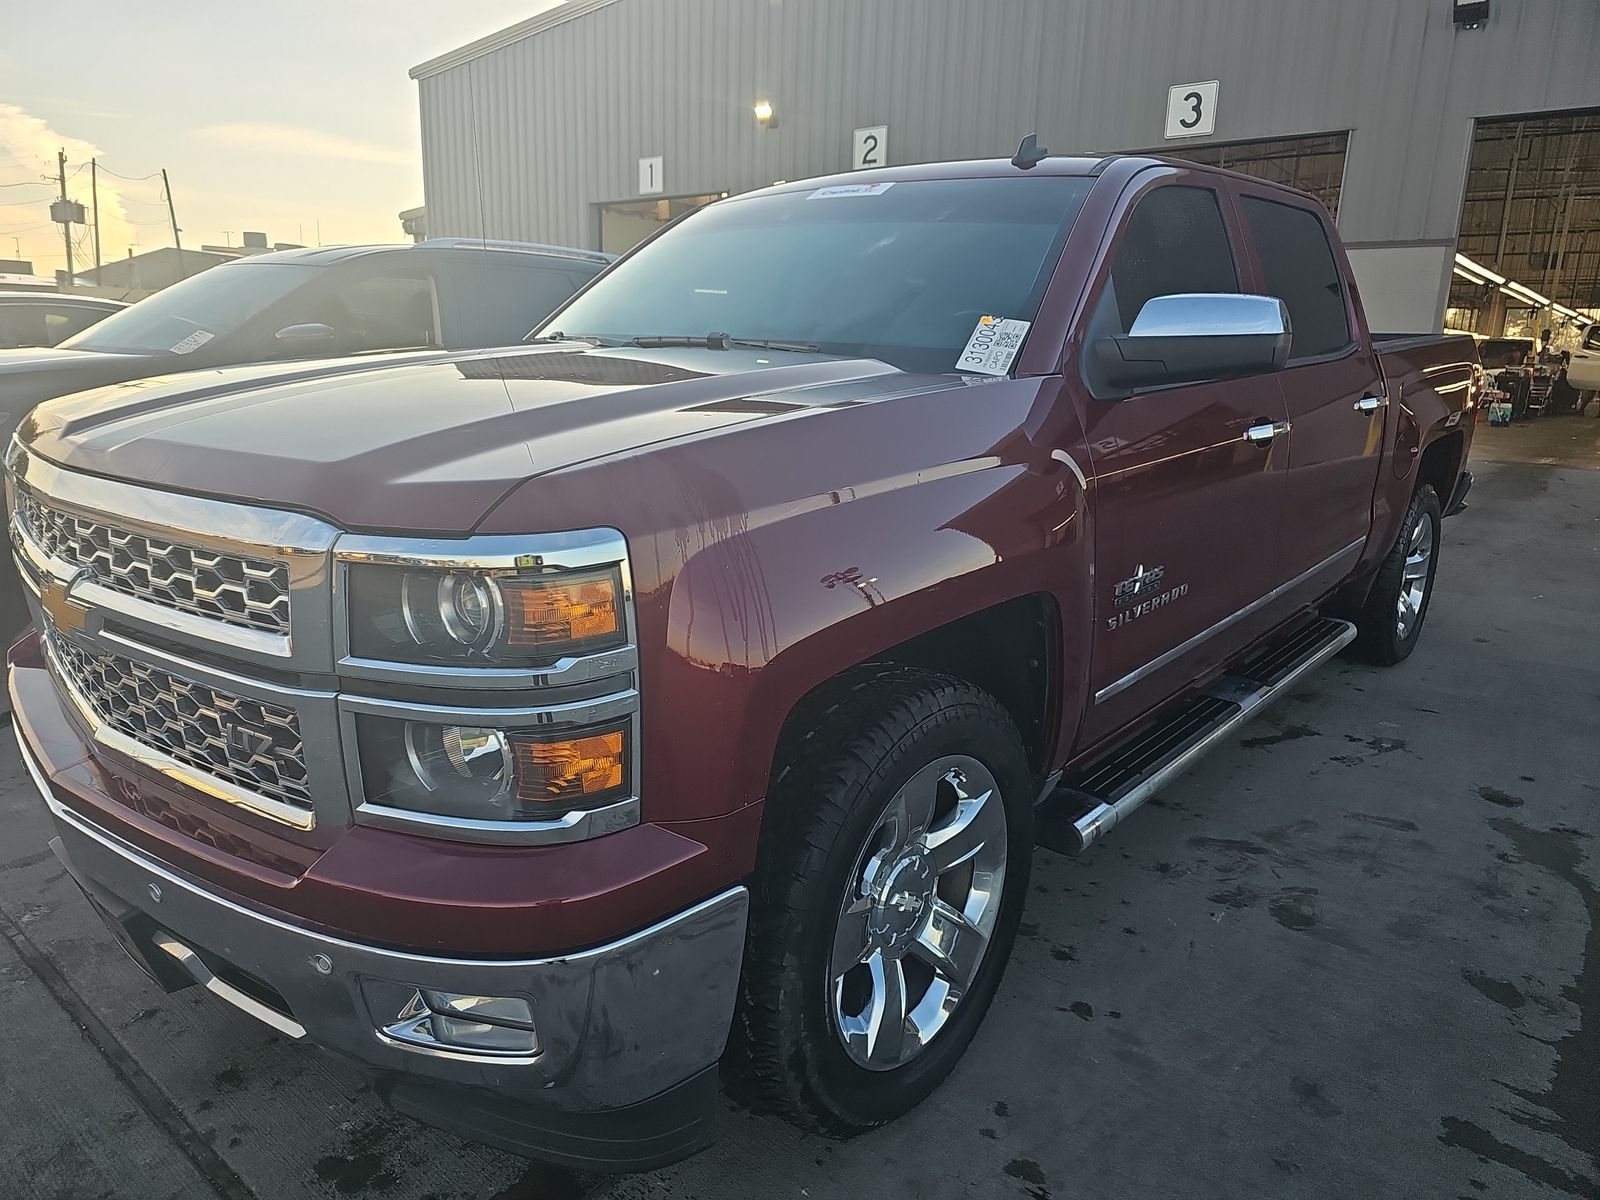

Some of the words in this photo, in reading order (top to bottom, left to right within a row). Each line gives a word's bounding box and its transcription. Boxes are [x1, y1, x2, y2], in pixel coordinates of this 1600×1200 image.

[1179, 91, 1203, 129] 3
[862, 134, 878, 165] 2
[648, 162, 654, 188] 1
[988, 350, 1004, 370] CAPO
[1105, 582, 1189, 632] SILVERADO
[226, 722, 272, 754] LTZ
